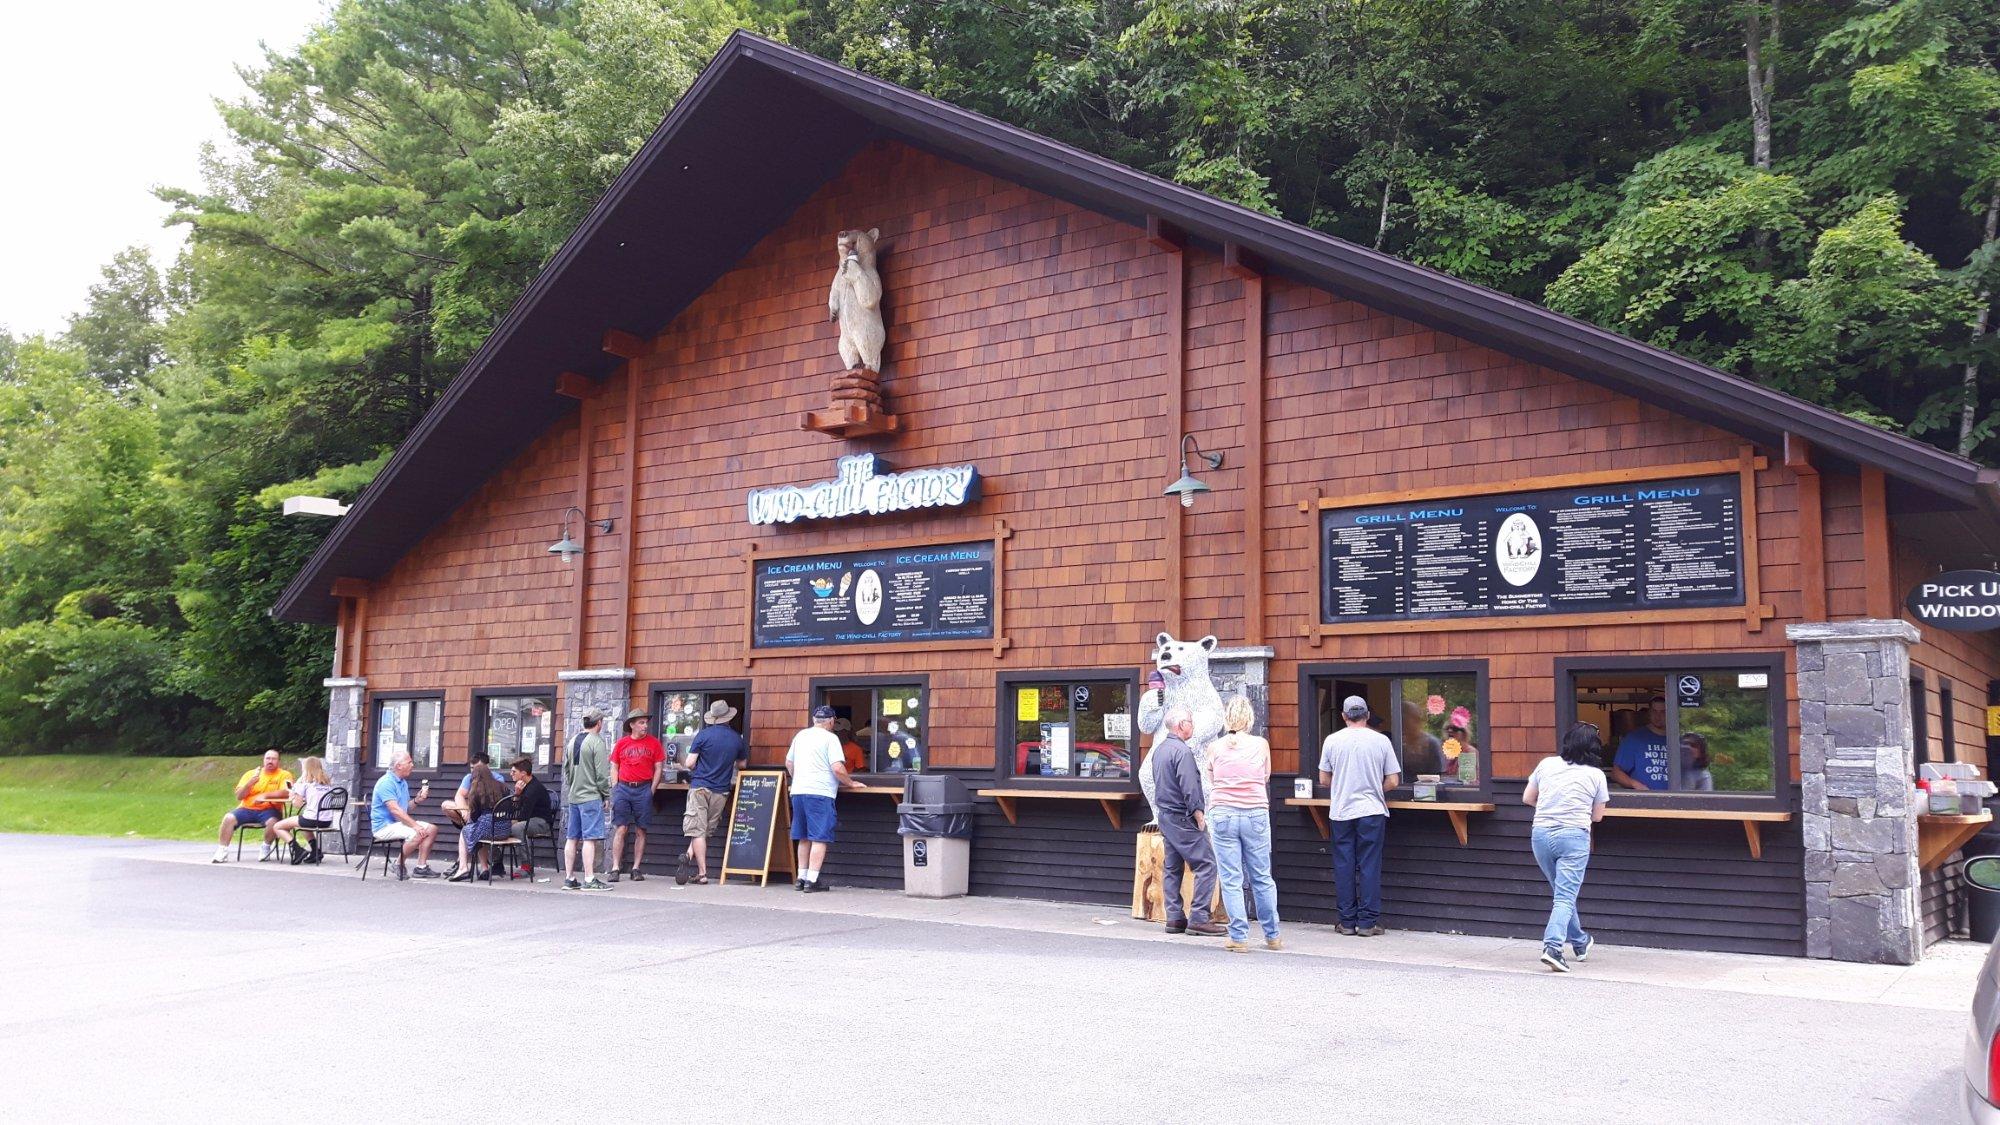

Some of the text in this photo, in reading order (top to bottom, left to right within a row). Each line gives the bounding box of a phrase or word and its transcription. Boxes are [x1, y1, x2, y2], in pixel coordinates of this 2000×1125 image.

[841, 459, 874, 486] THE
[876, 467, 973, 511] FACTORY
[1574, 488, 1700, 506] GRILL MENU
[1355, 508, 1463, 524] GRILL MENU
[896, 551, 980, 564] ICE CREAM MENU
[767, 561, 843, 575] ICE CREAM MENU
[1922, 581, 2000, 598] PICK U
[493, 718, 517, 730] OPEN
[1644, 751, 1658, 759] NO
